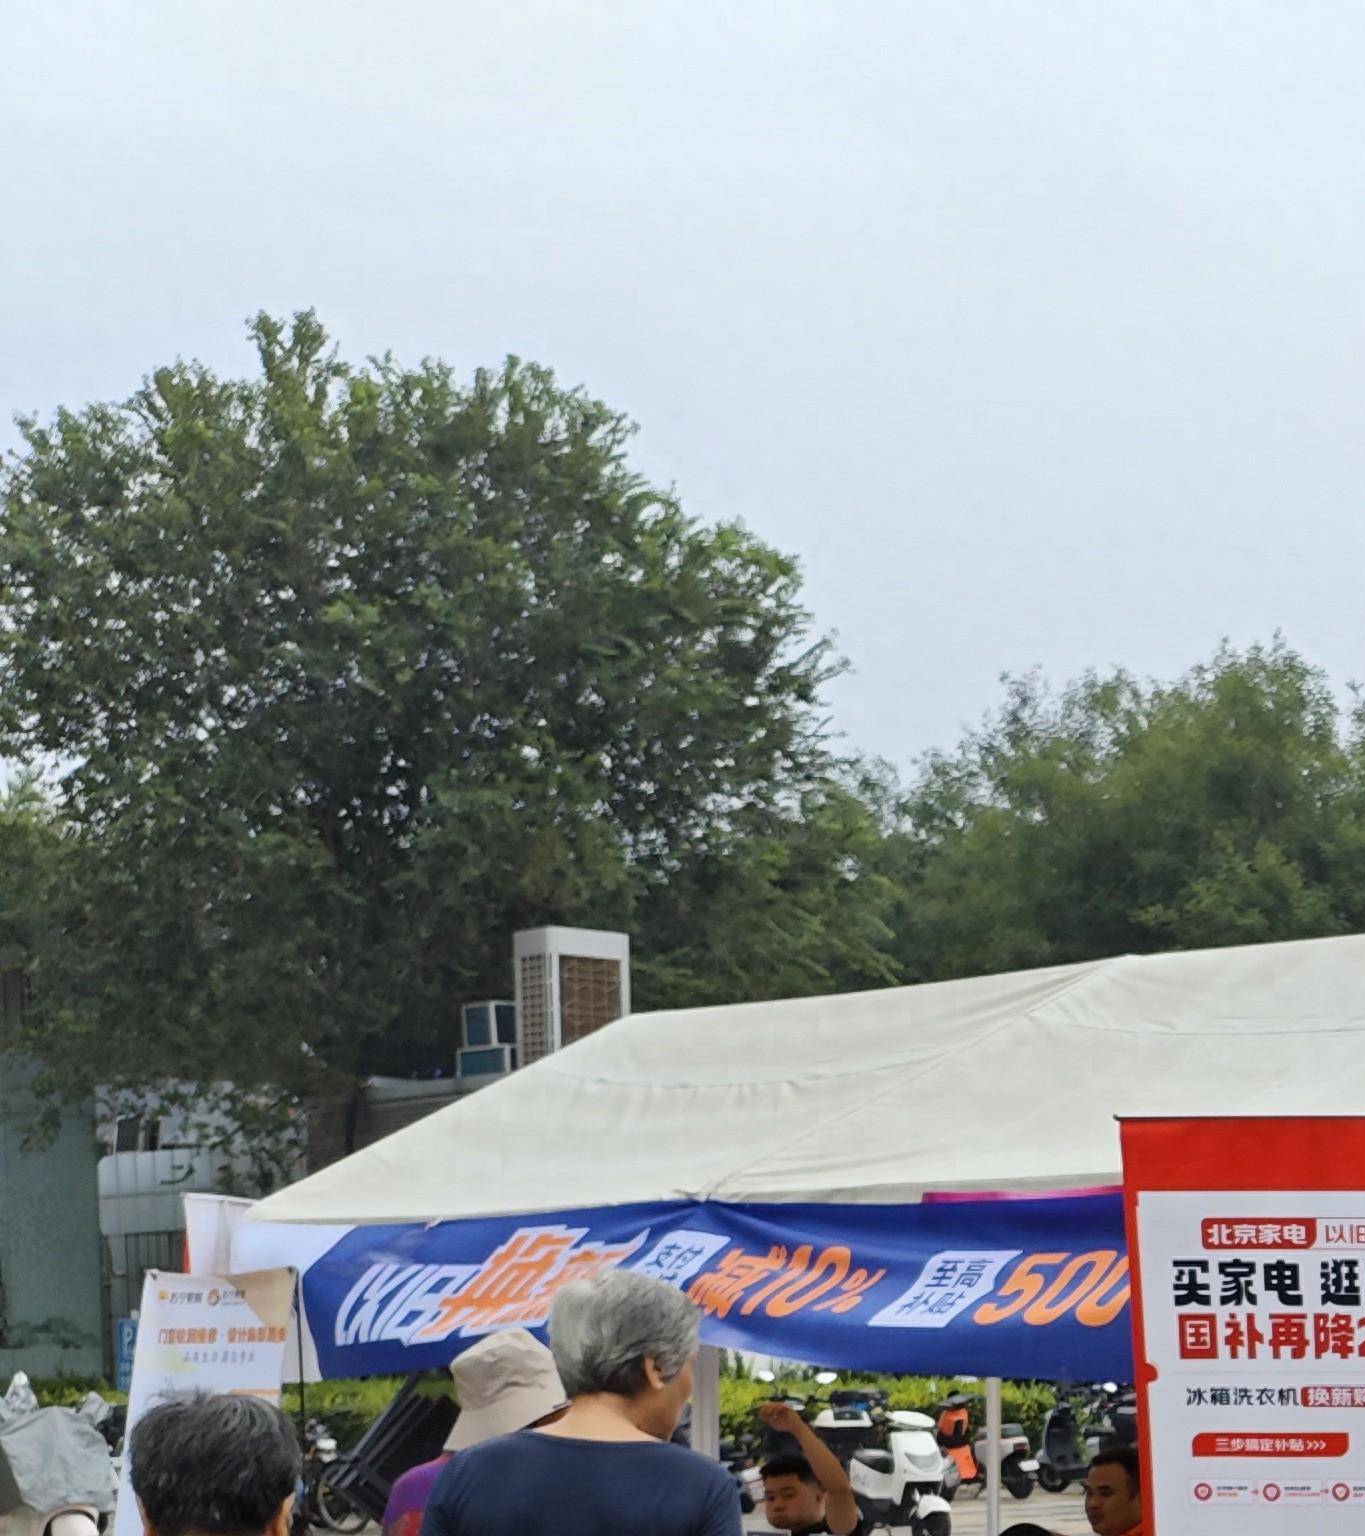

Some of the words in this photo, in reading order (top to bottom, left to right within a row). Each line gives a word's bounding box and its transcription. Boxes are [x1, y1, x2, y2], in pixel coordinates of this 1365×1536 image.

[1207, 1225, 1308, 1246] 北京家电
[925, 1257, 985, 1289] 至高
[1172, 1259, 1304, 1307] 买家电
[1185, 1387, 1299, 1407] 冰箱洗衣机
